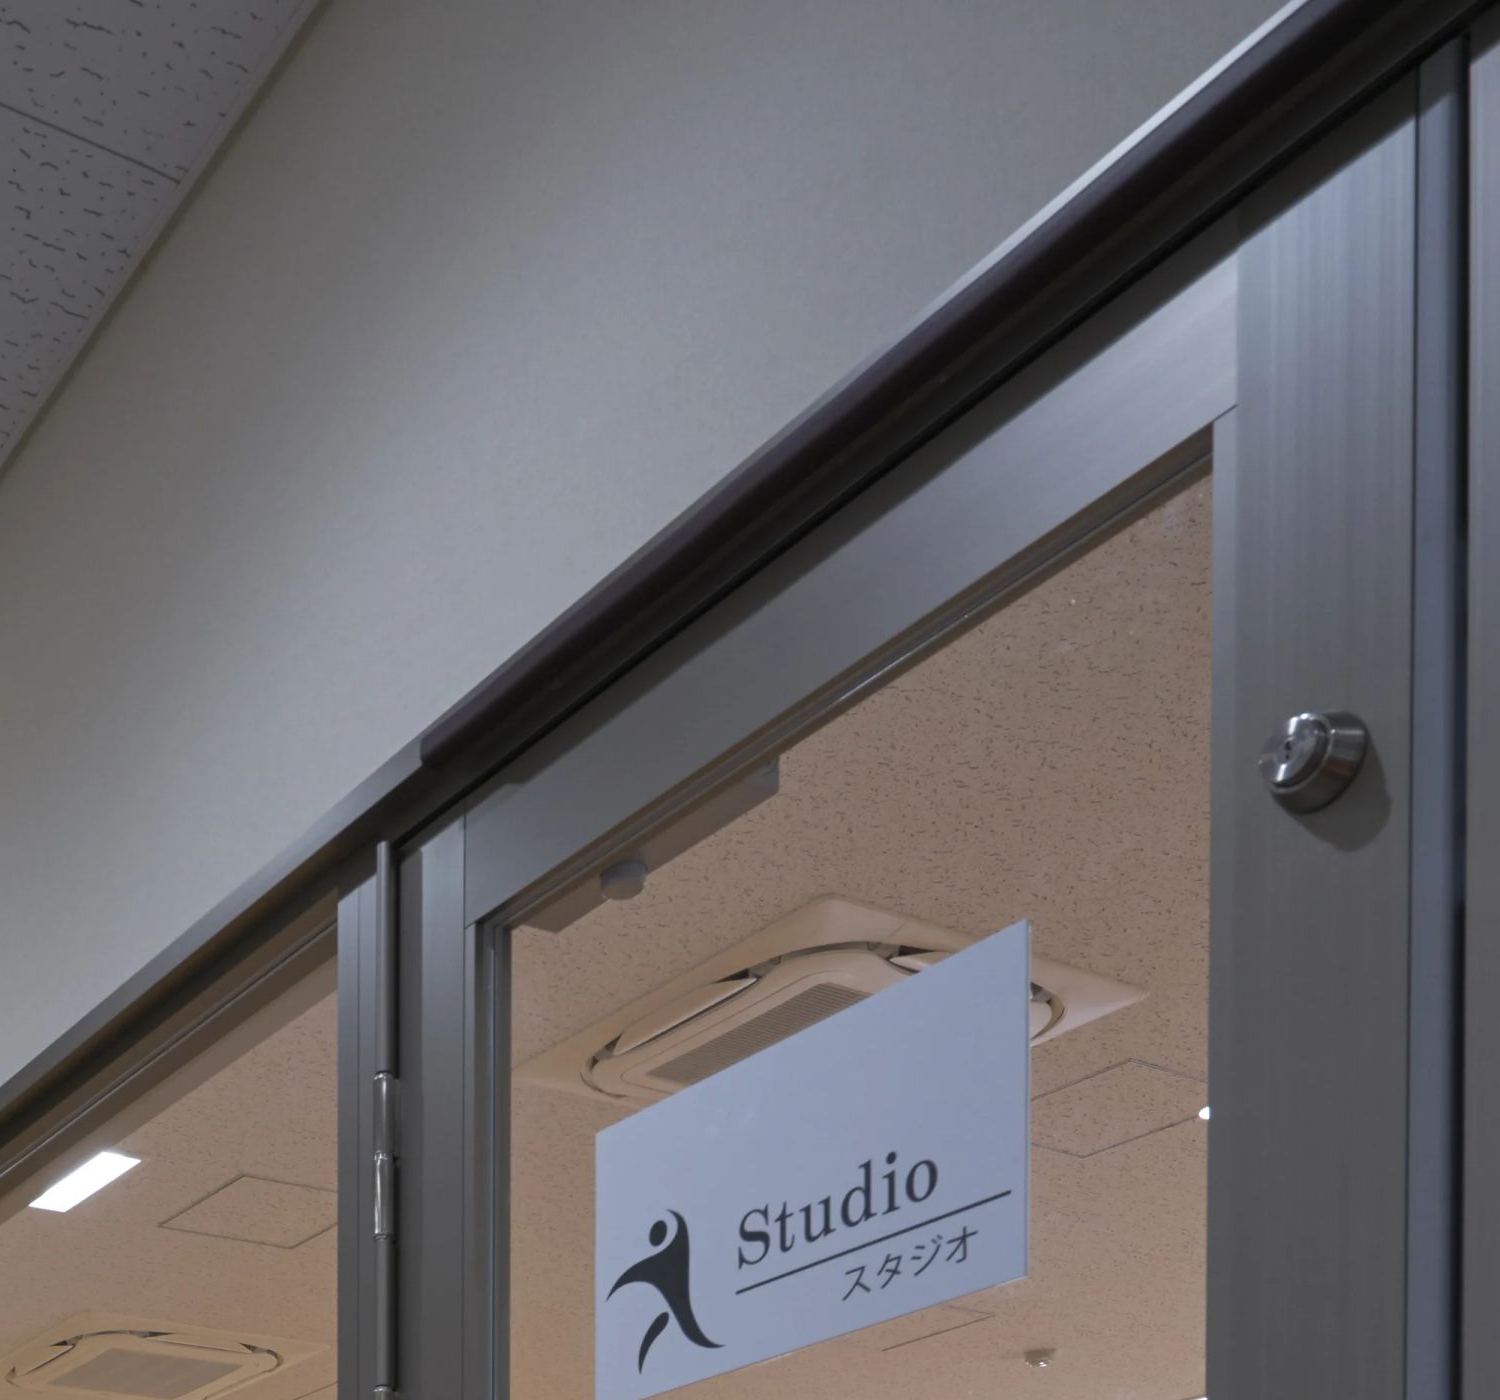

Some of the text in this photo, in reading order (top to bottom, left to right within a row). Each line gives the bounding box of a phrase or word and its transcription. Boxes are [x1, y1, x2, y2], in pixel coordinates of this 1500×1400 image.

[737, 1150, 939, 1270] Studio
[842, 1225, 979, 1301] スタジオ
